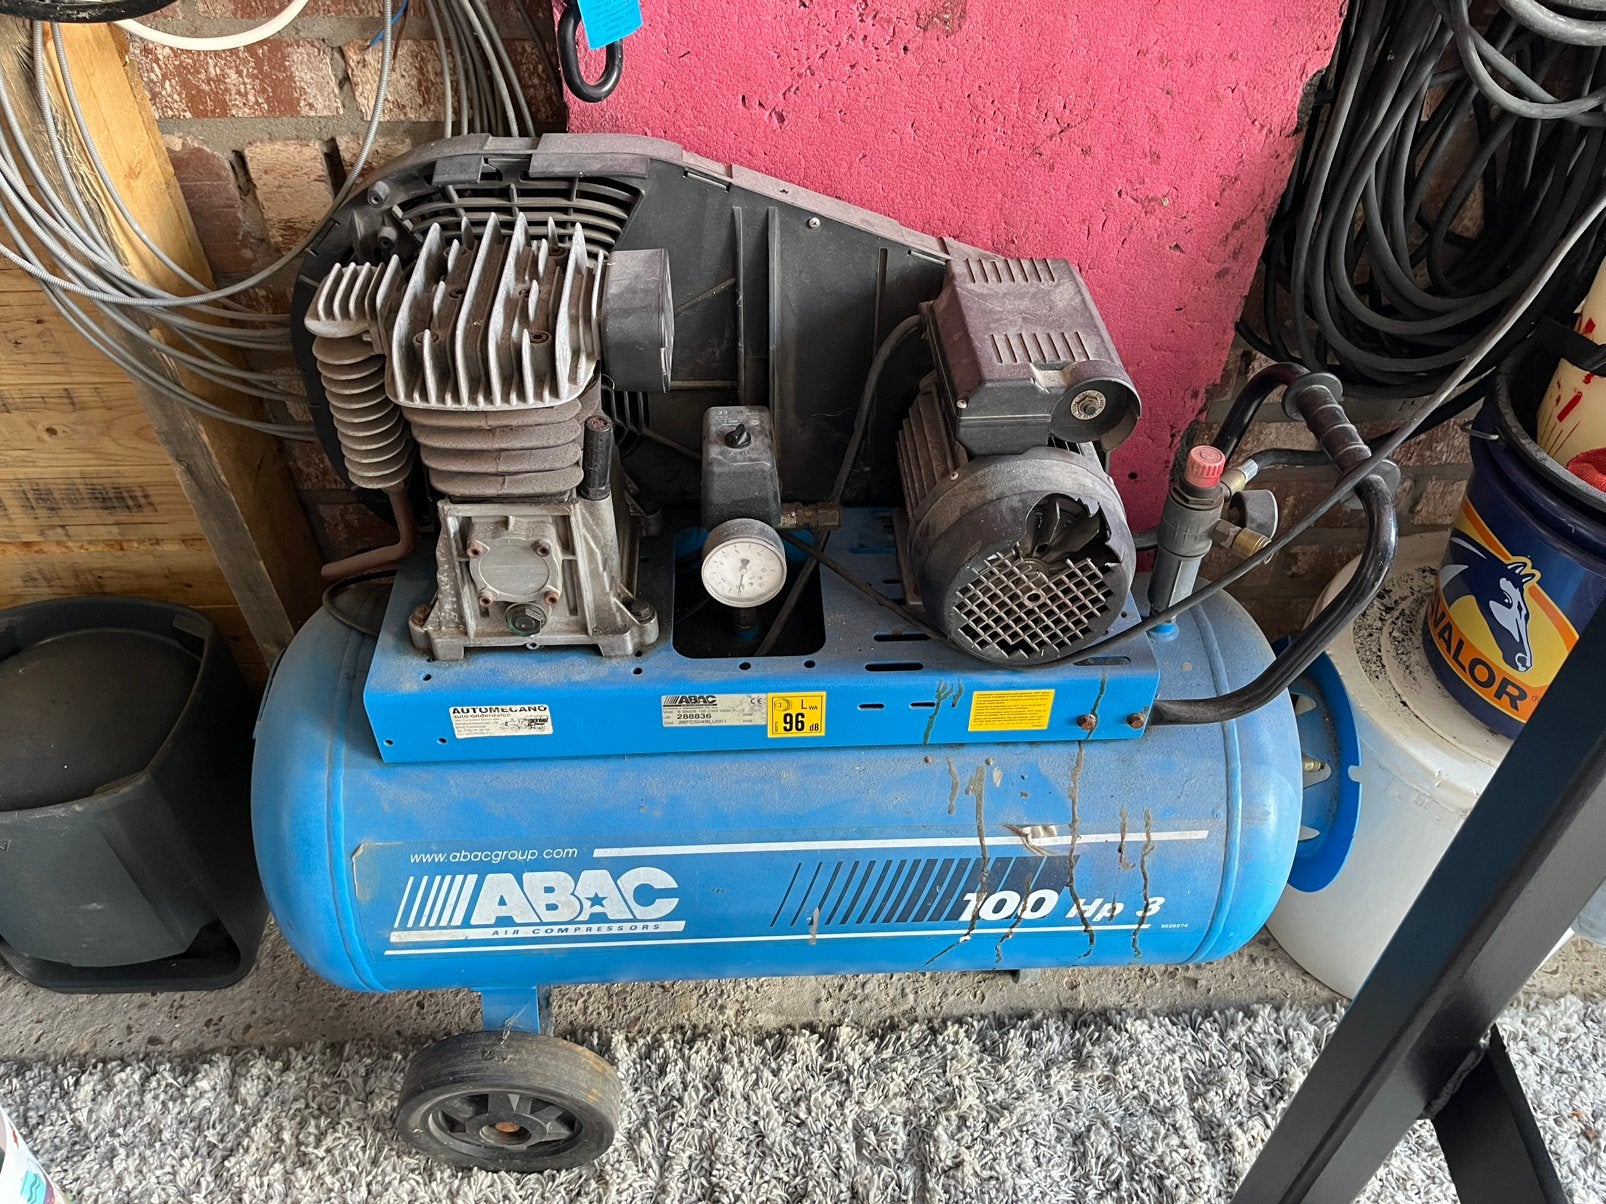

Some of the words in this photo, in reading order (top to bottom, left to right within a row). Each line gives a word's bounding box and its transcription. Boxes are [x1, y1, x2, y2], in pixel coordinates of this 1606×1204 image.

[678, 695, 718, 704] ABAC
[801, 699, 807, 710] L
[452, 705, 547, 714] AUTOMECANO
[783, 712, 805, 732] 96
[810, 723, 819, 731] dB
[409, 846, 578, 864] www.abacgroup.com
[470, 866, 680, 925] ABAC
[958, 889, 1059, 921] 100
[1065, 898, 1125, 921] Hp
[1135, 896, 1166, 917] 3
[491, 928, 520, 936] AIR
[532, 923, 661, 934] COMPRESSORS
